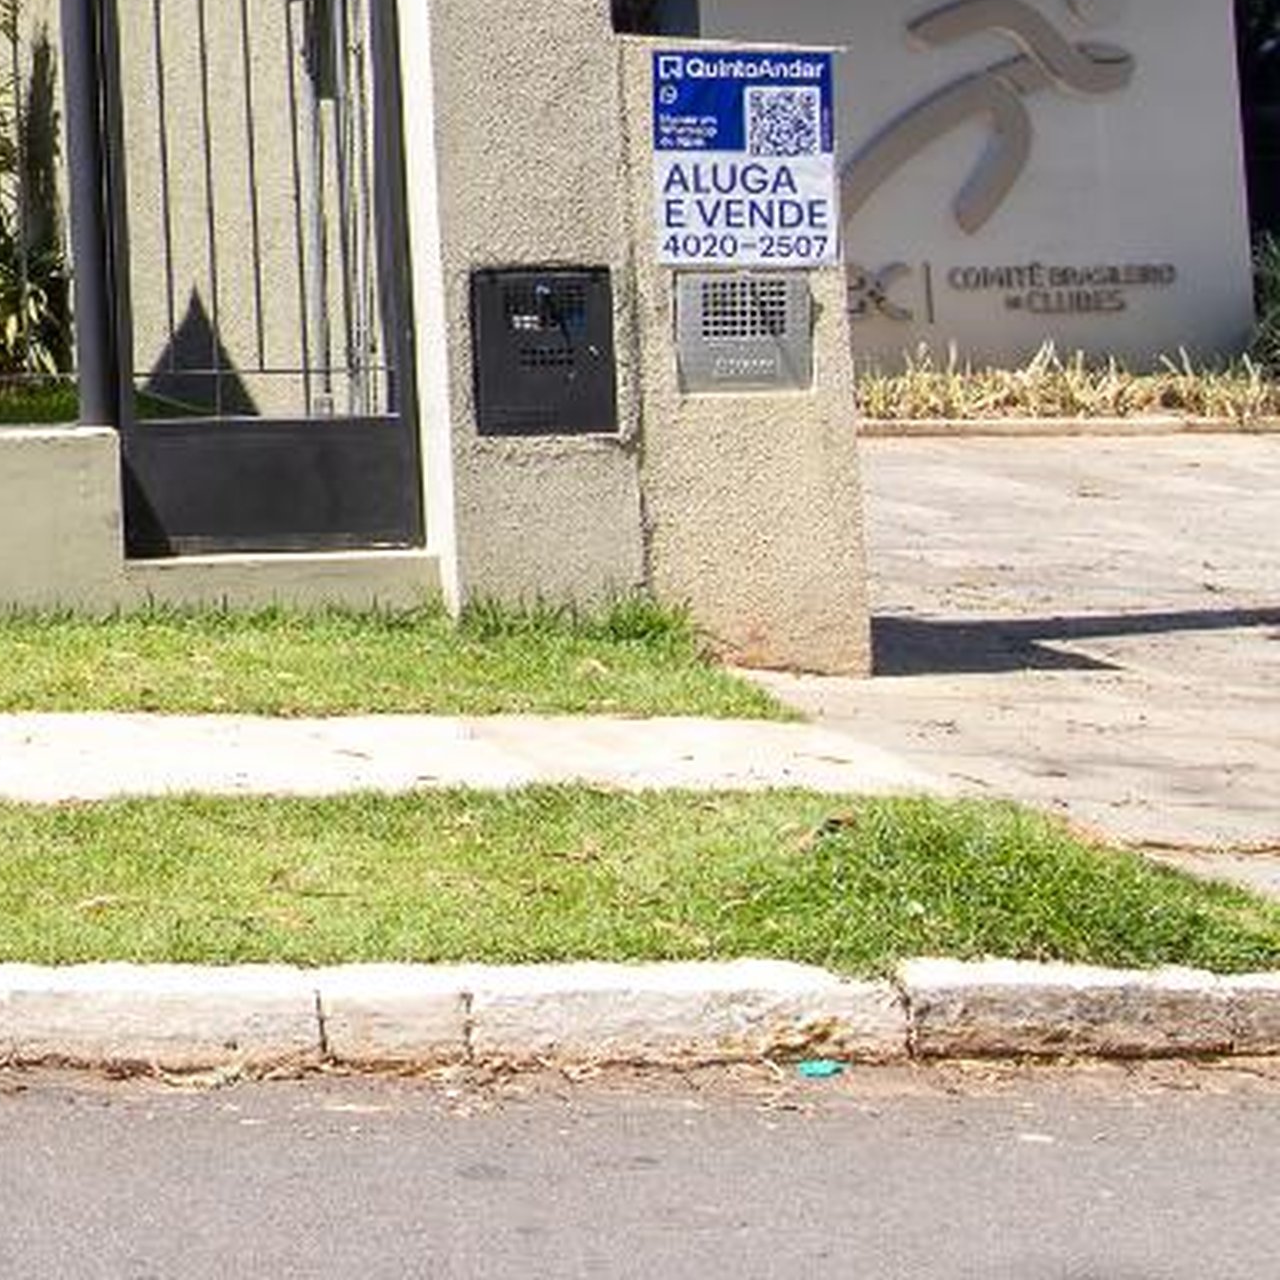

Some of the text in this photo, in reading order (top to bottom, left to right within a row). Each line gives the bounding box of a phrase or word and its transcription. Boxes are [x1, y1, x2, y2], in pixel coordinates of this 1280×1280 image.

[686, 57, 825, 79] QuintoAndar
[663, 163, 798, 195] ALUGA
[665, 198, 828, 229] E VENDE
[663, 234, 828, 258] 4020-2507
[948, 261, 1176, 291] COMITÊ BRASILEIRO
[1025, 289, 1128, 314] CLUBES
